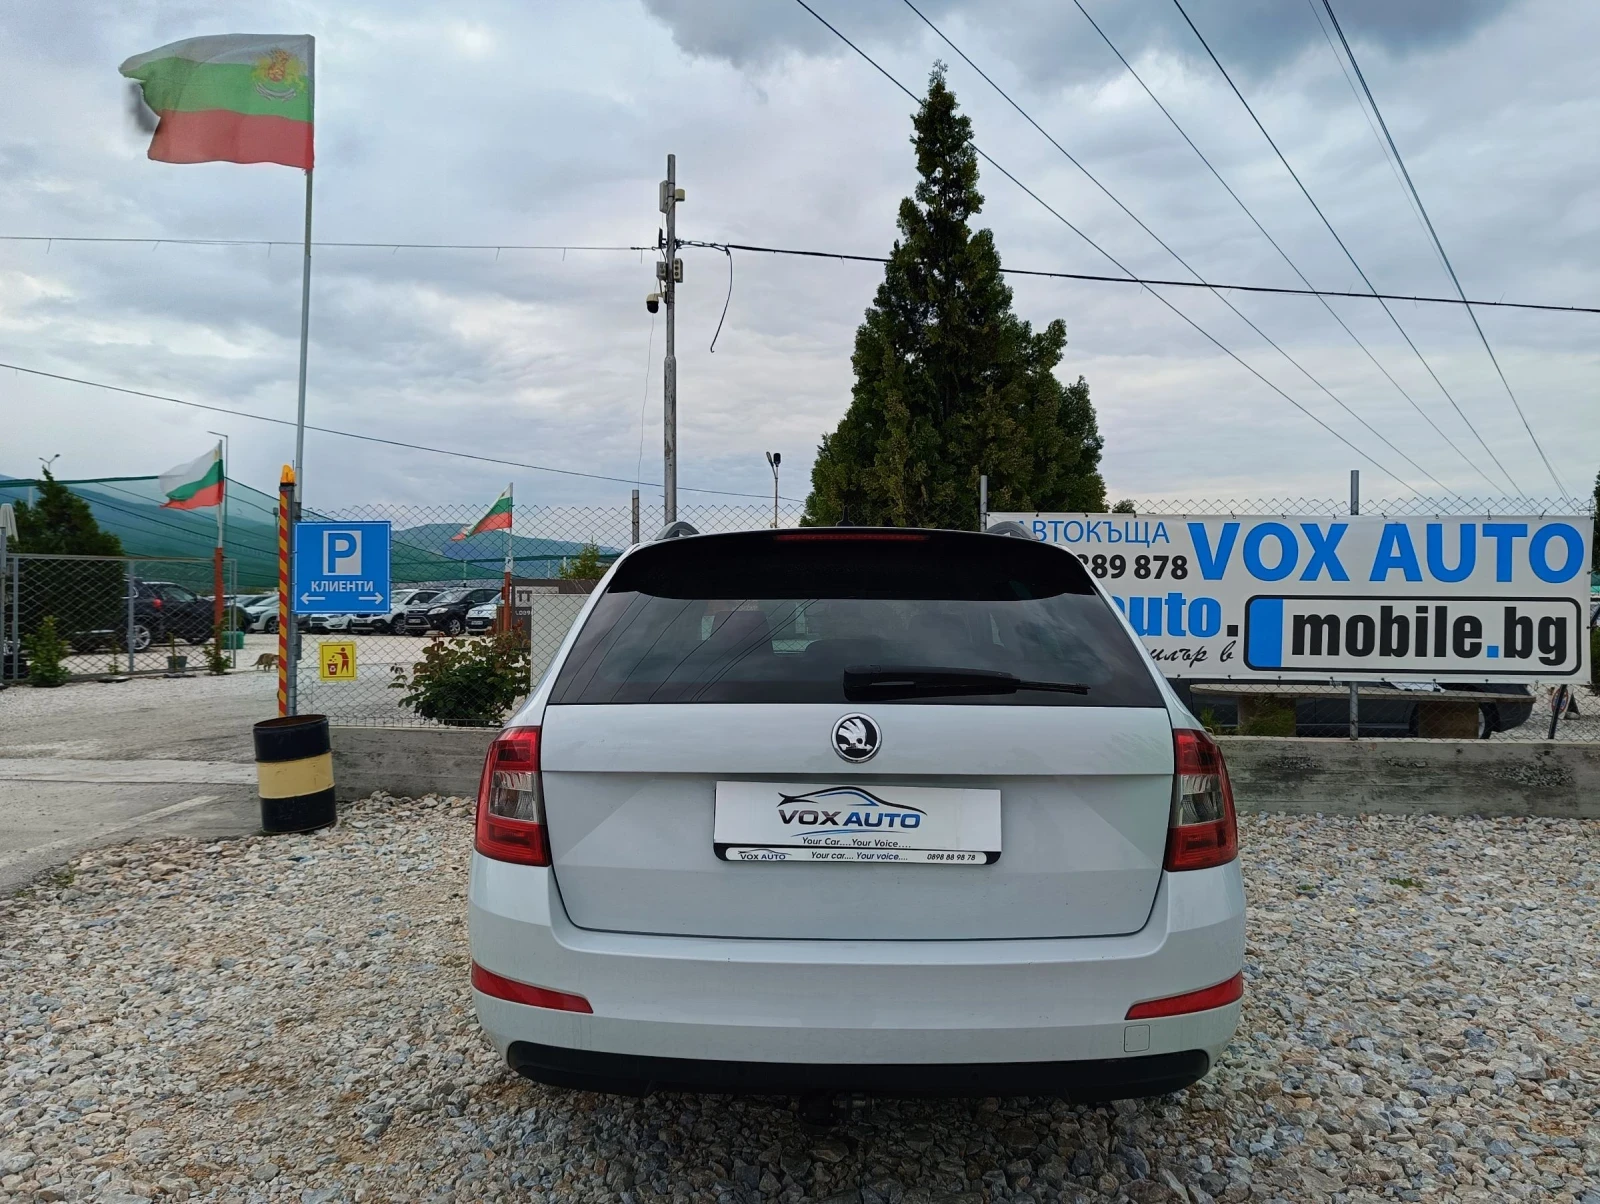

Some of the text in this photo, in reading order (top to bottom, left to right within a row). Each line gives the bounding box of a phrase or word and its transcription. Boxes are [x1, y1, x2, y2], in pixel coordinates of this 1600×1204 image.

[1018, 520, 1170, 548] ВТОКЪЩА
[326, 532, 359, 574] P
[1187, 522, 1584, 584] VOX AUTO
[1134, 555, 1188, 580] 878
[311, 580, 374, 592] КЛИЕНТИ
[1291, 605, 1567, 666] mobile.bg
[802, 837, 822, 846] Your
[811, 851, 830, 859] Your
[856, 852, 875, 860] Your
[926, 853, 945, 861] 0898
[945, 853, 955, 861] 88
